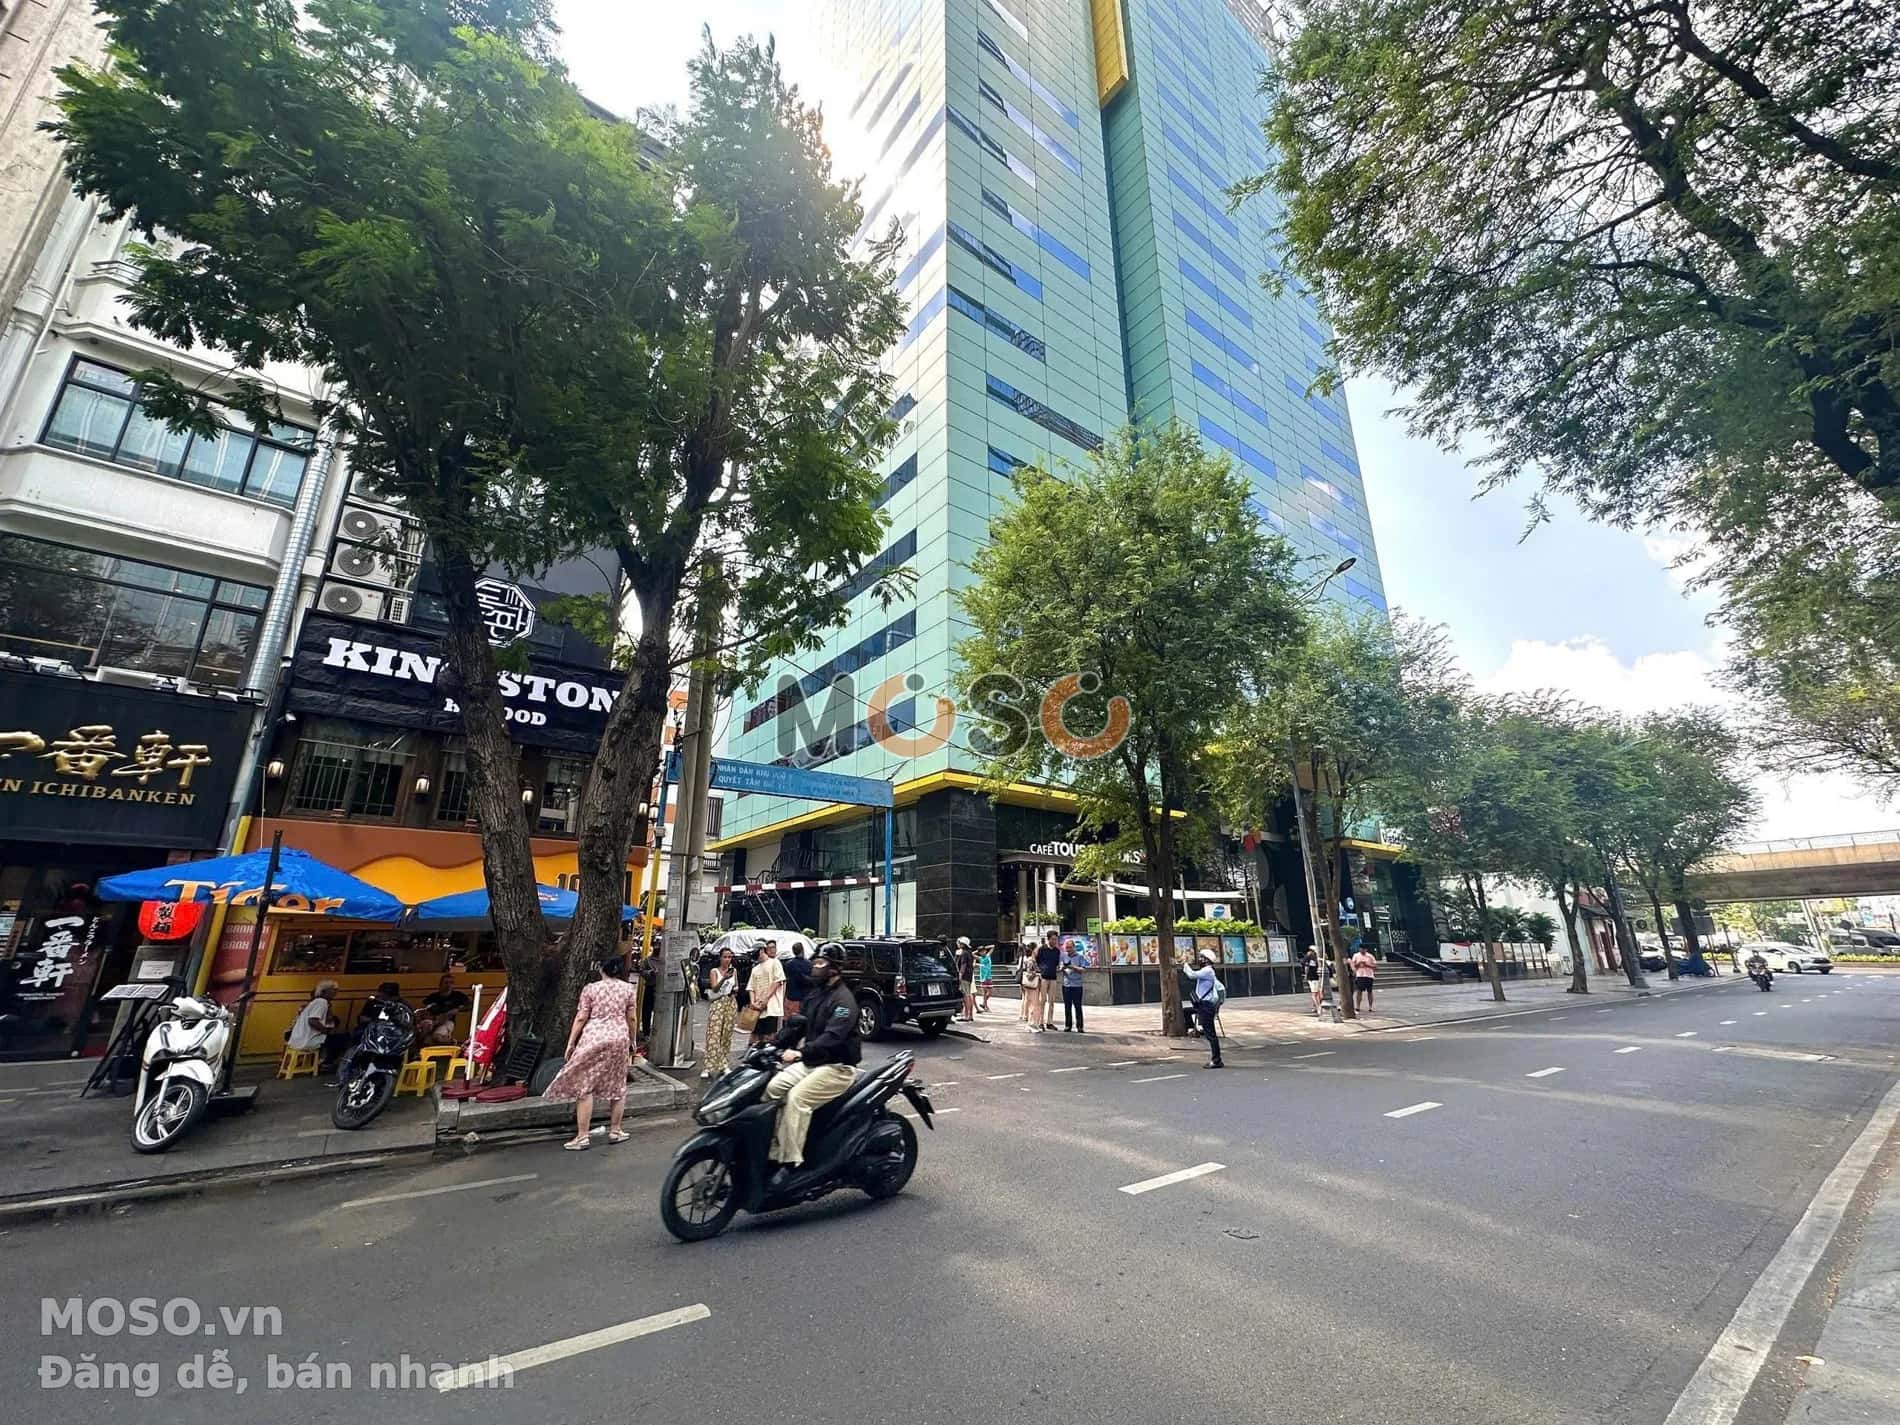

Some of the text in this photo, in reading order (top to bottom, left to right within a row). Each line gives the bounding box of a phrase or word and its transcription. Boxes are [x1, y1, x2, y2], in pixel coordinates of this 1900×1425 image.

[322, 637, 620, 713] KINSTON
[30, 781, 197, 806] ICHIBANKEN
[19, 915, 85, 988] 一番軒
